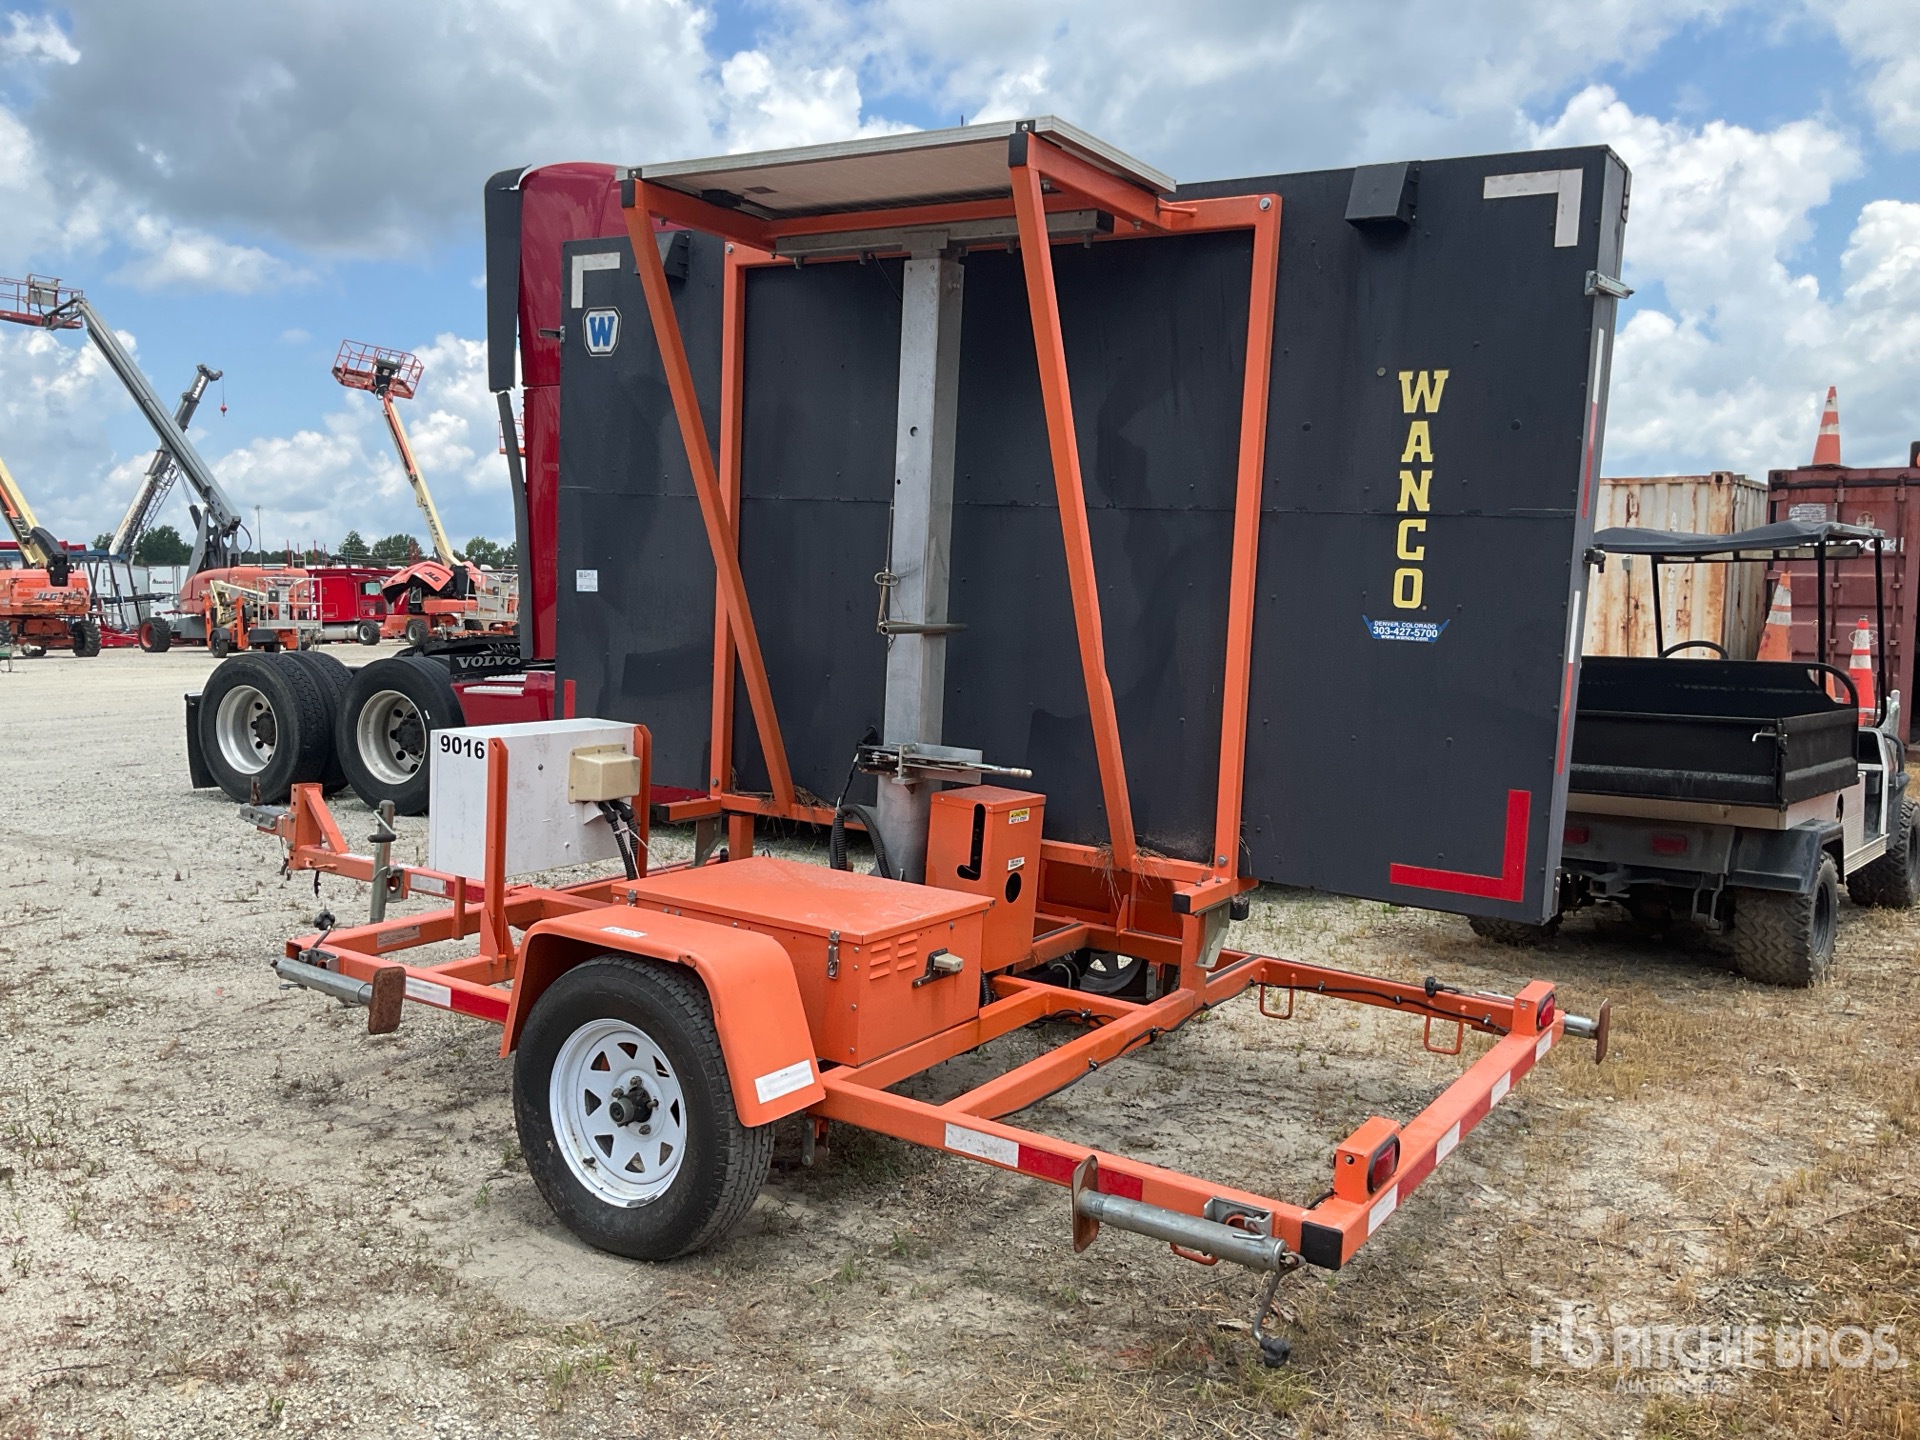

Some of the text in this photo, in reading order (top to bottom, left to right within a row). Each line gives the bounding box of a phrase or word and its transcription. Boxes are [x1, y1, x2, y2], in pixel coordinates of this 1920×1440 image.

[589, 315, 615, 347] W
[1393, 369, 1450, 609] WANCO
[424, 571, 441, 583] JLG
[1374, 620, 1437, 630] DENVER, COLORADO
[1373, 626, 1438, 638] 303-427-5700
[1380, 634, 1429, 642] www.wanco.com
[456, 655, 521, 669] VOLVO
[440, 734, 485, 760] 9016
